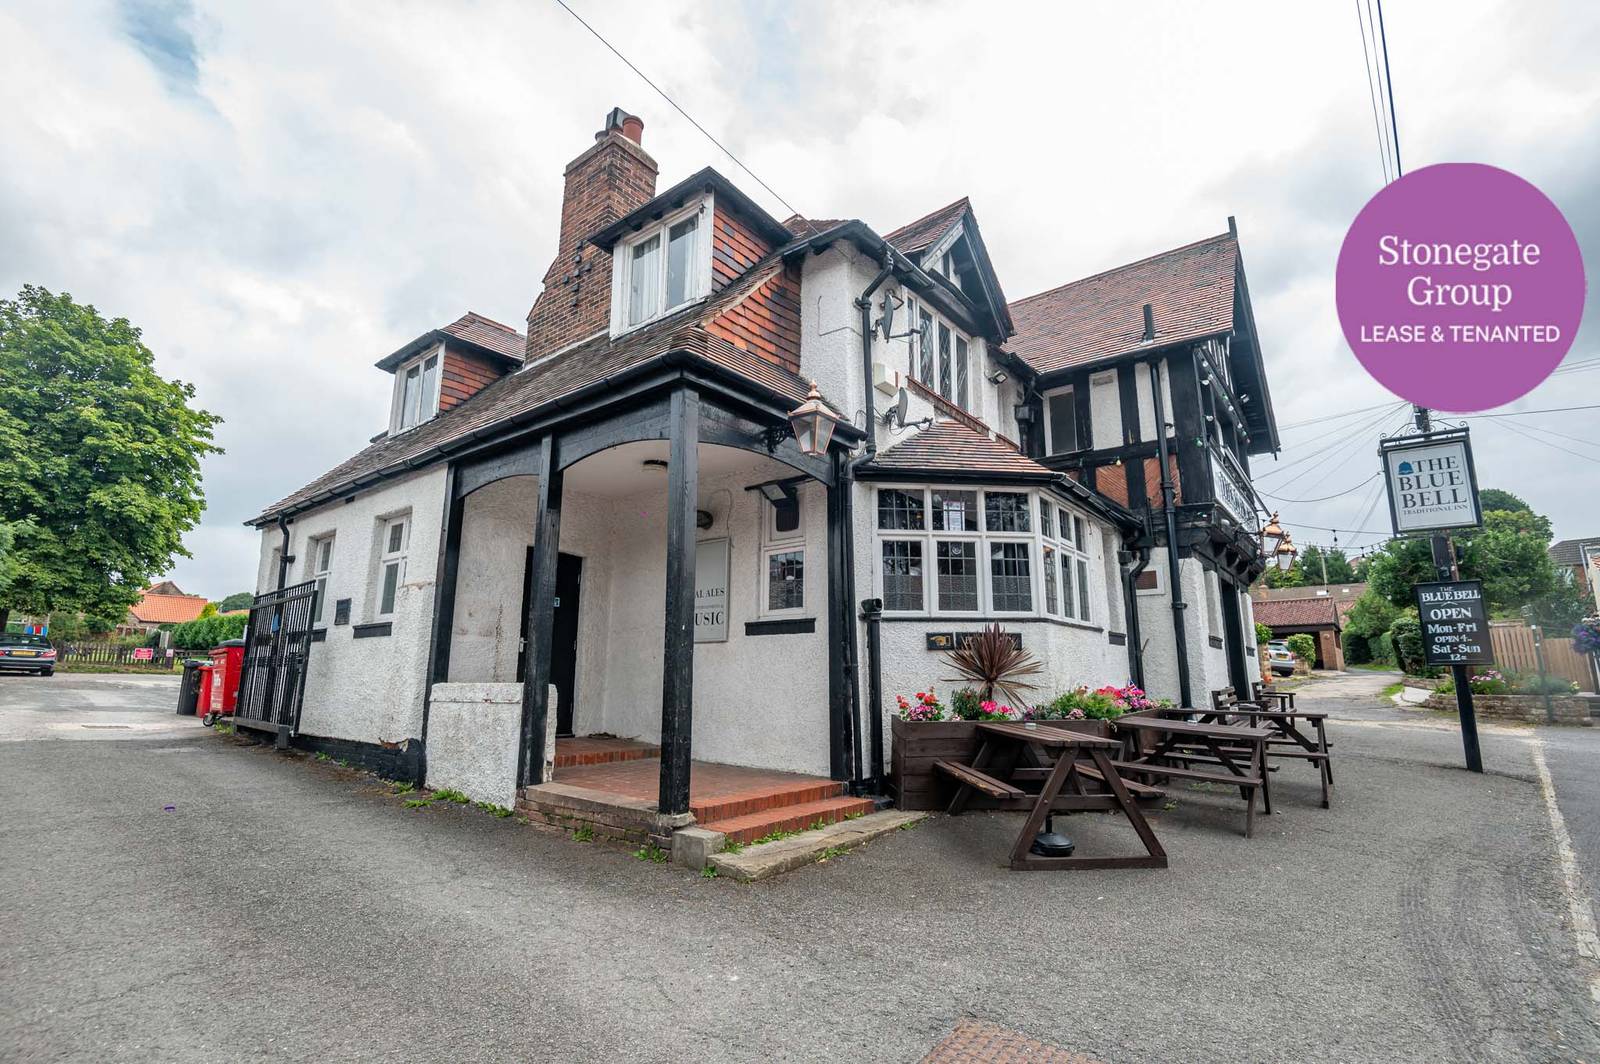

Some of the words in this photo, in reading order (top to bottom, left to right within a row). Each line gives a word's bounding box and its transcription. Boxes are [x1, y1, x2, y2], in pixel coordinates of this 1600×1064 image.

[1412, 456, 1459, 472] THE
[1398, 470, 1464, 491] BLUE
[1402, 488, 1467, 509] BELL
[705, 588, 724, 597] ALES
[1421, 592, 1453, 601] BLUE
[1454, 590, 1481, 600] BELL
[695, 611, 724, 625] USIC
[1430, 608, 1472, 620] OPEN
[1434, 635, 1460, 643] OPEN
